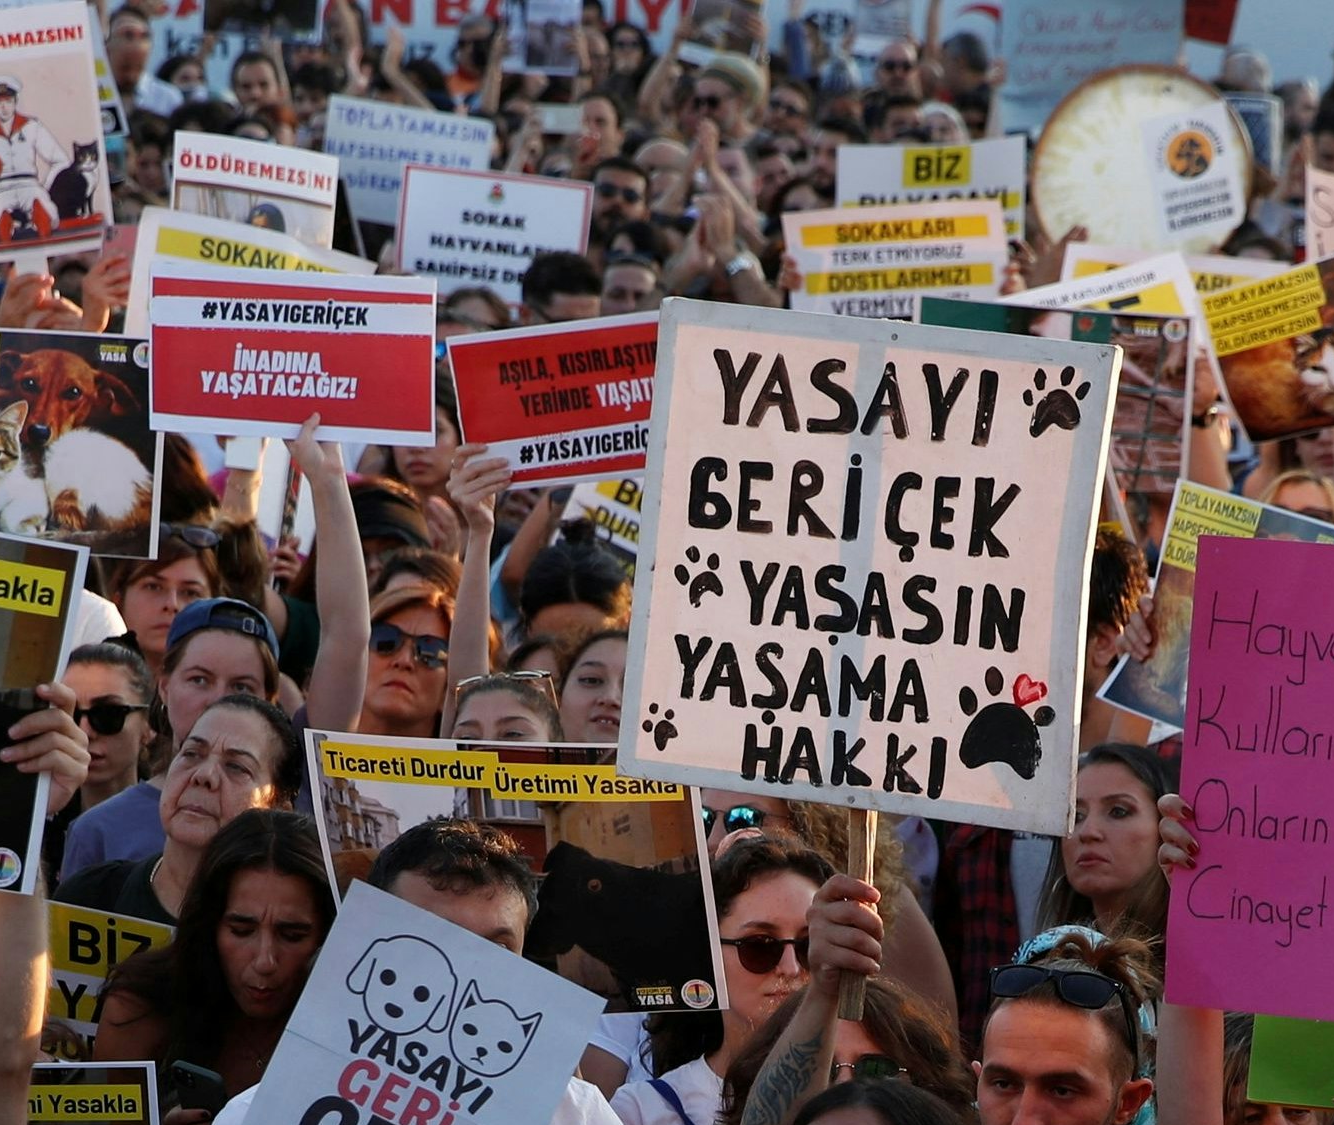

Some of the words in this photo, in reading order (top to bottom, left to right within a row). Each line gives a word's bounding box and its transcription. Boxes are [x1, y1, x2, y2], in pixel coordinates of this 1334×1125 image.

[180, 150, 332, 192] ÖLDÜREMEZSİN!
[913, 149, 962, 183] BİZ
[462, 210, 526, 230] SOKAK
[836, 218, 956, 243] SOKAKLARI
[415, 260, 498, 282] SAHİPSİZ
[832, 249, 872, 267] TERK
[875, 246, 964, 265] ETMİYORUZ
[828, 265, 971, 292] DOSTLARIMIZI
[1204, 268, 1319, 313] TOPLAYAMAZSIN
[202, 300, 369, 331] #YASAYIGERİÇEK
[1212, 288, 1325, 331] HAPSEDEMEZSİN
[1215, 312, 1322, 352] ÖLDÜREMEZSİN
[234, 342, 321, 375] İNADINA
[200, 370, 358, 401] YAŞATACAĞIZ!
[519, 386, 593, 418] YERİNDE
[596, 377, 654, 412] YAŞAT
[713, 347, 1000, 446] YASAYI
[520, 423, 649, 465] #YASAYIGERİÇ
[1179, 488, 1258, 527] TOPLAYAMAZSIN
[740, 560, 1026, 653] YAŞASIN
[674, 634, 930, 725] YAŞAMA
[325, 749, 407, 777] Ticareti
[410, 752, 486, 782] Durdur
[493, 762, 581, 795] Üretimi
[584, 768, 678, 796] Yasakla
[740, 722, 948, 800] HAKKI
[1193, 778, 1331, 846] Onların
[1187, 864, 1331, 948] Cinayet
[636, 992, 675, 1007] YASA
[347, 1019, 495, 1116] YASAYI
[47, 1093, 138, 1115] Yasakla
